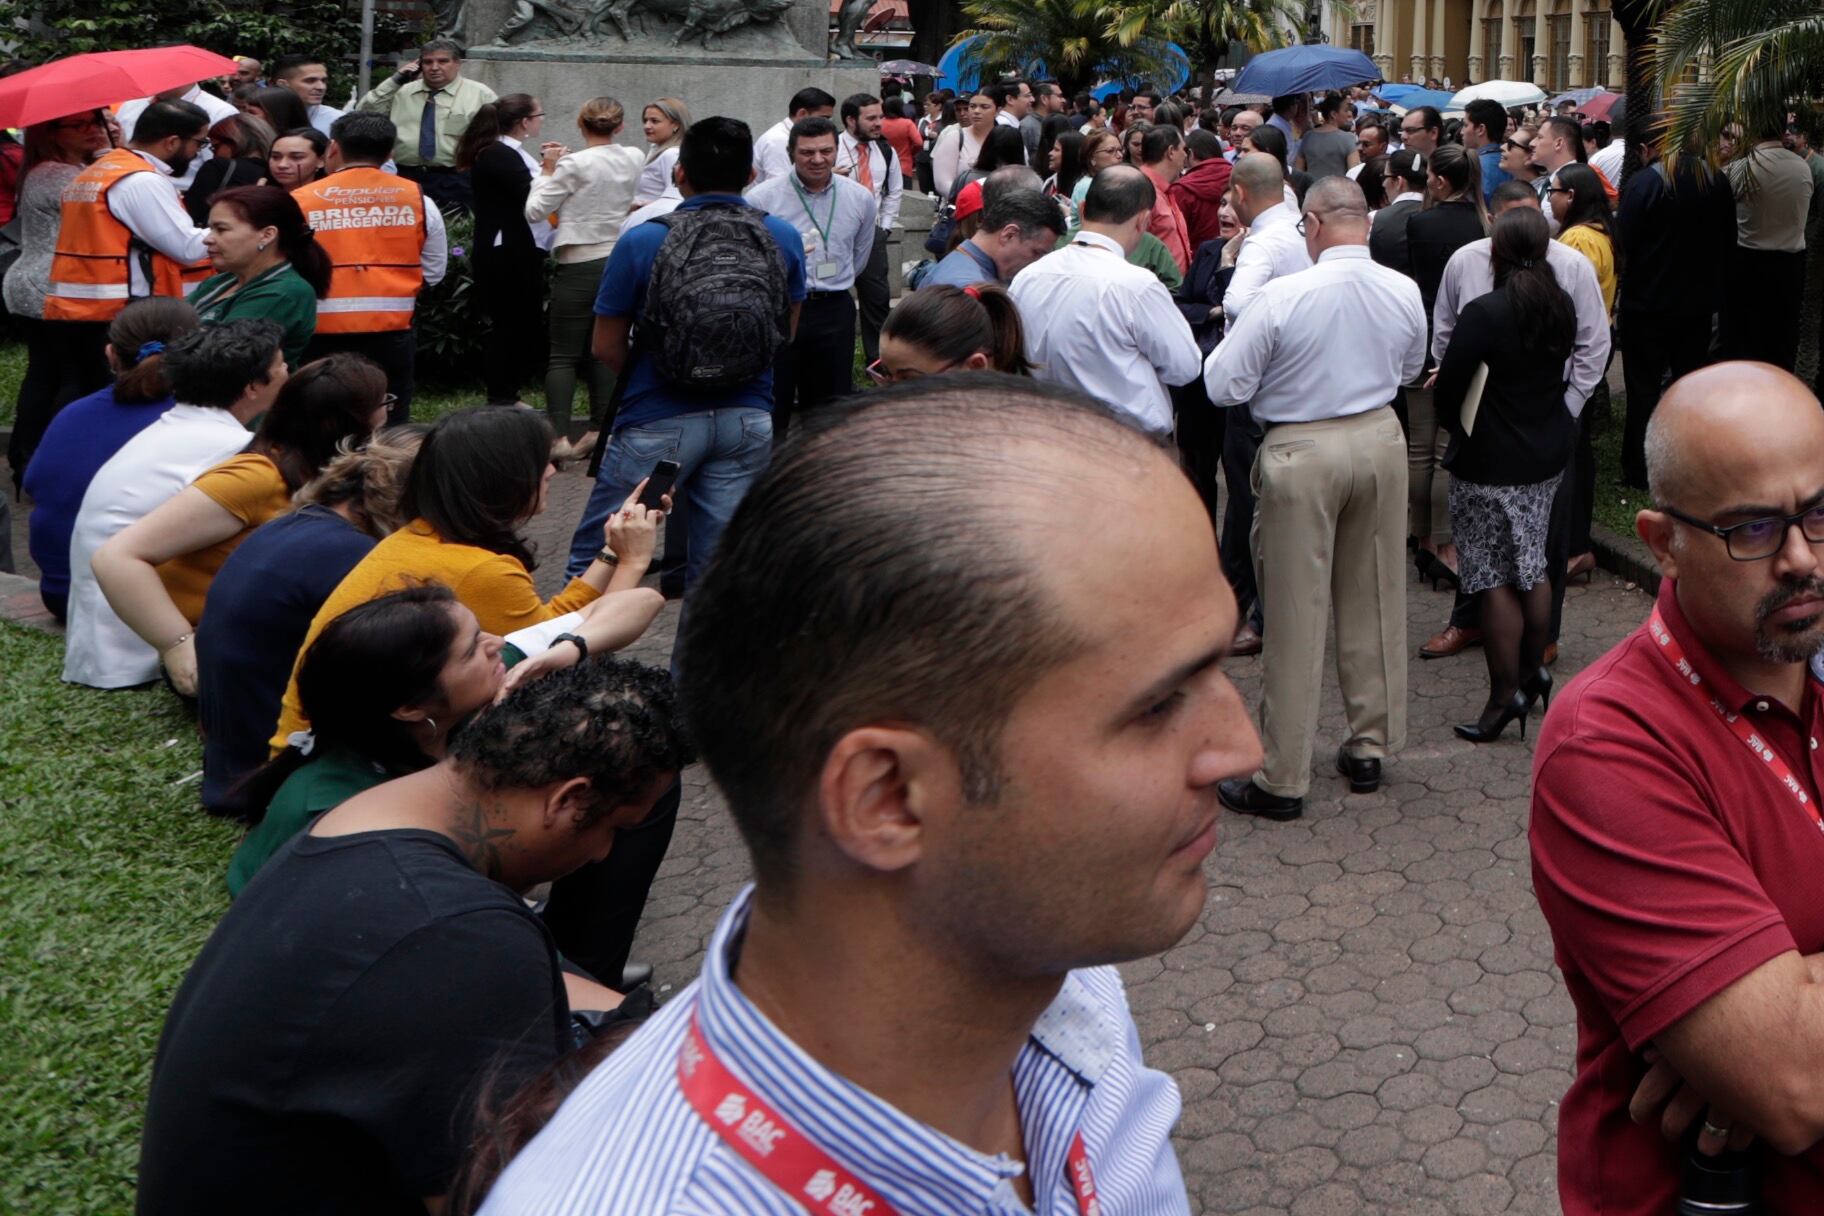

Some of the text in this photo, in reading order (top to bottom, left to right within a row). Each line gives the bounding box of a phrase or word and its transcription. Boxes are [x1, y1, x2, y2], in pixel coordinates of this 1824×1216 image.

[324, 186, 404, 199] Popular
[308, 206, 414, 221] BRIGADA
[310, 215, 416, 231] EMERGENCIAS
[1747, 734, 1764, 752] BAC
[739, 1109, 786, 1154] BAC
